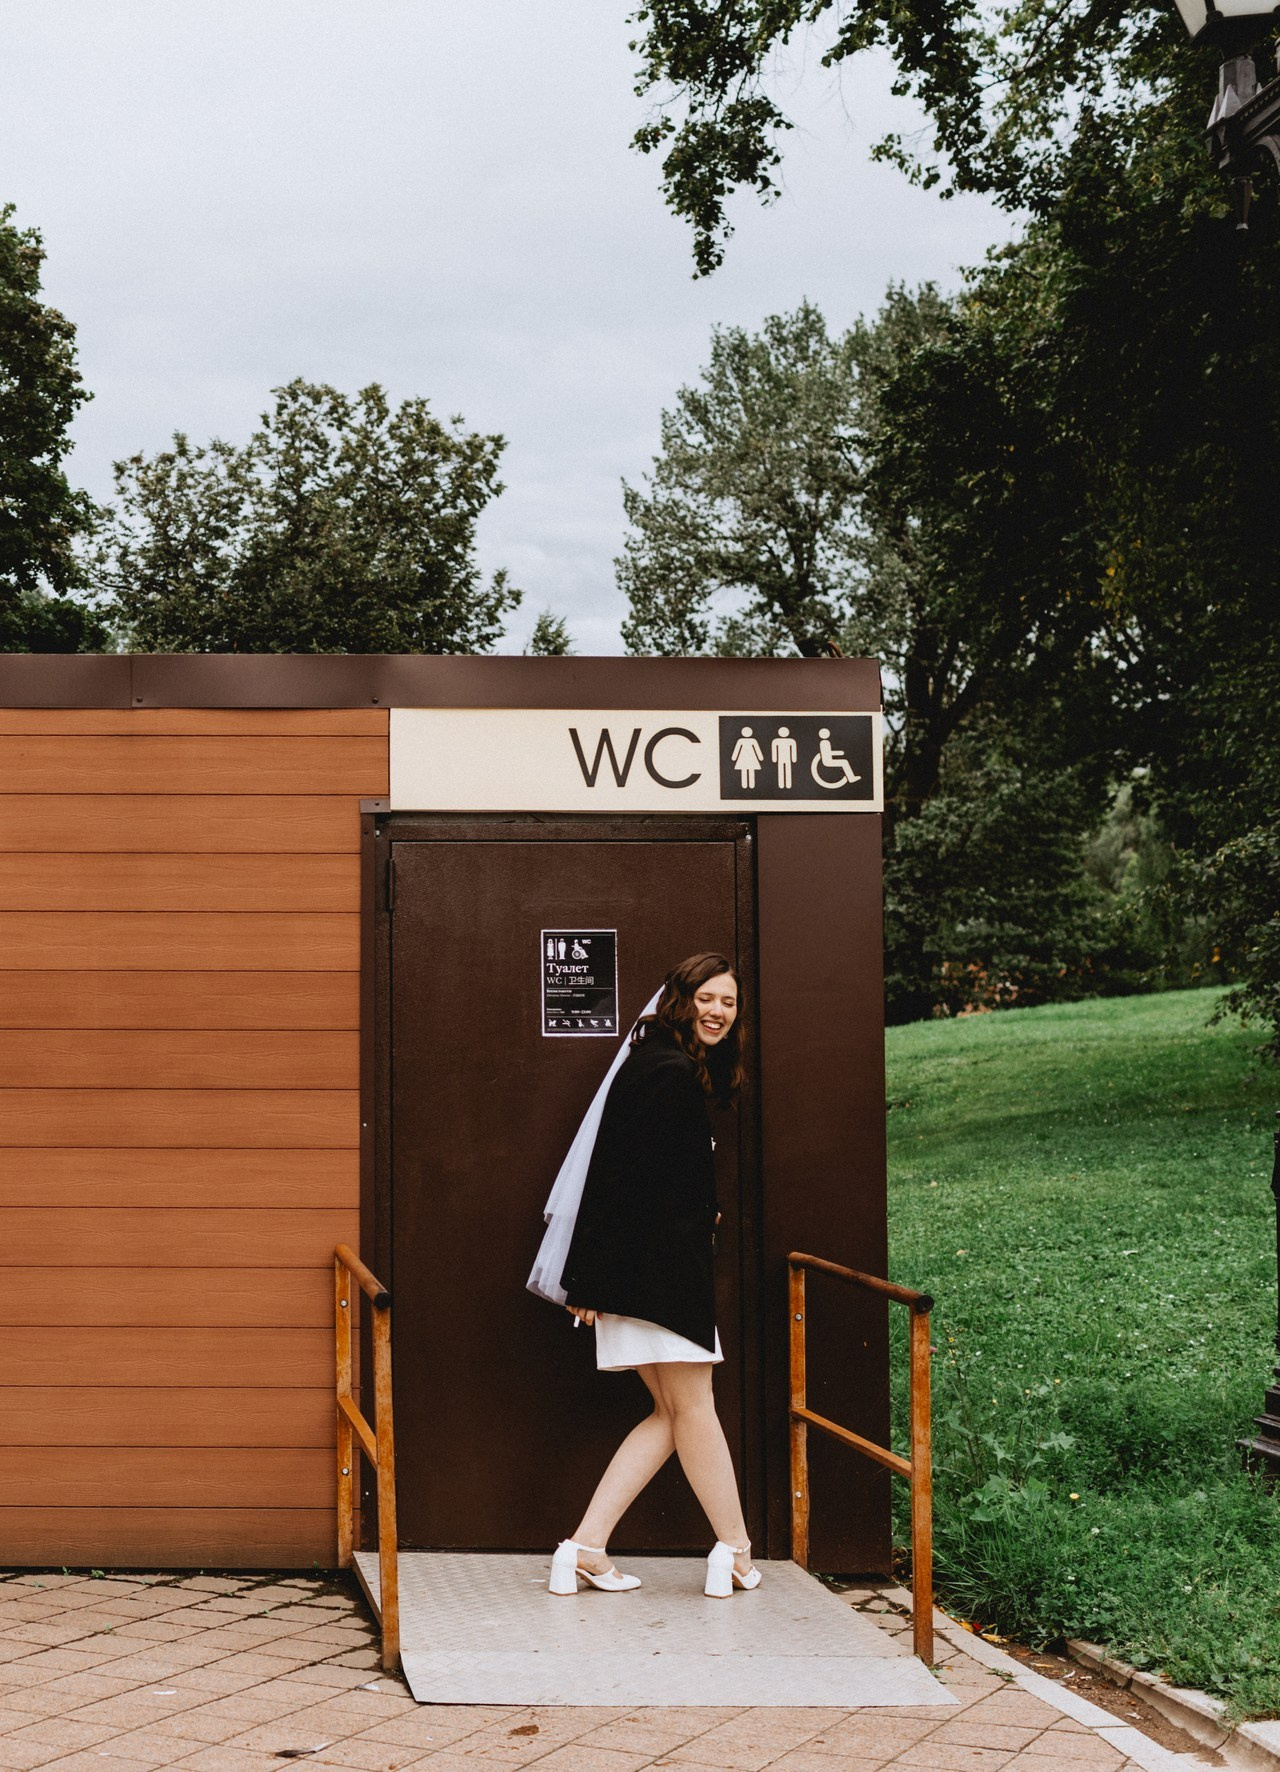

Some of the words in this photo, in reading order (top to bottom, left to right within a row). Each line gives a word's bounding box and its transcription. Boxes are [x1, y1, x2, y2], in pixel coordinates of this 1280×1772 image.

[568, 727, 702, 789] WC
[546, 963, 589, 976] Туалет
[546, 976, 563, 985] WC
[569, 976, 594, 985] 卫生间
